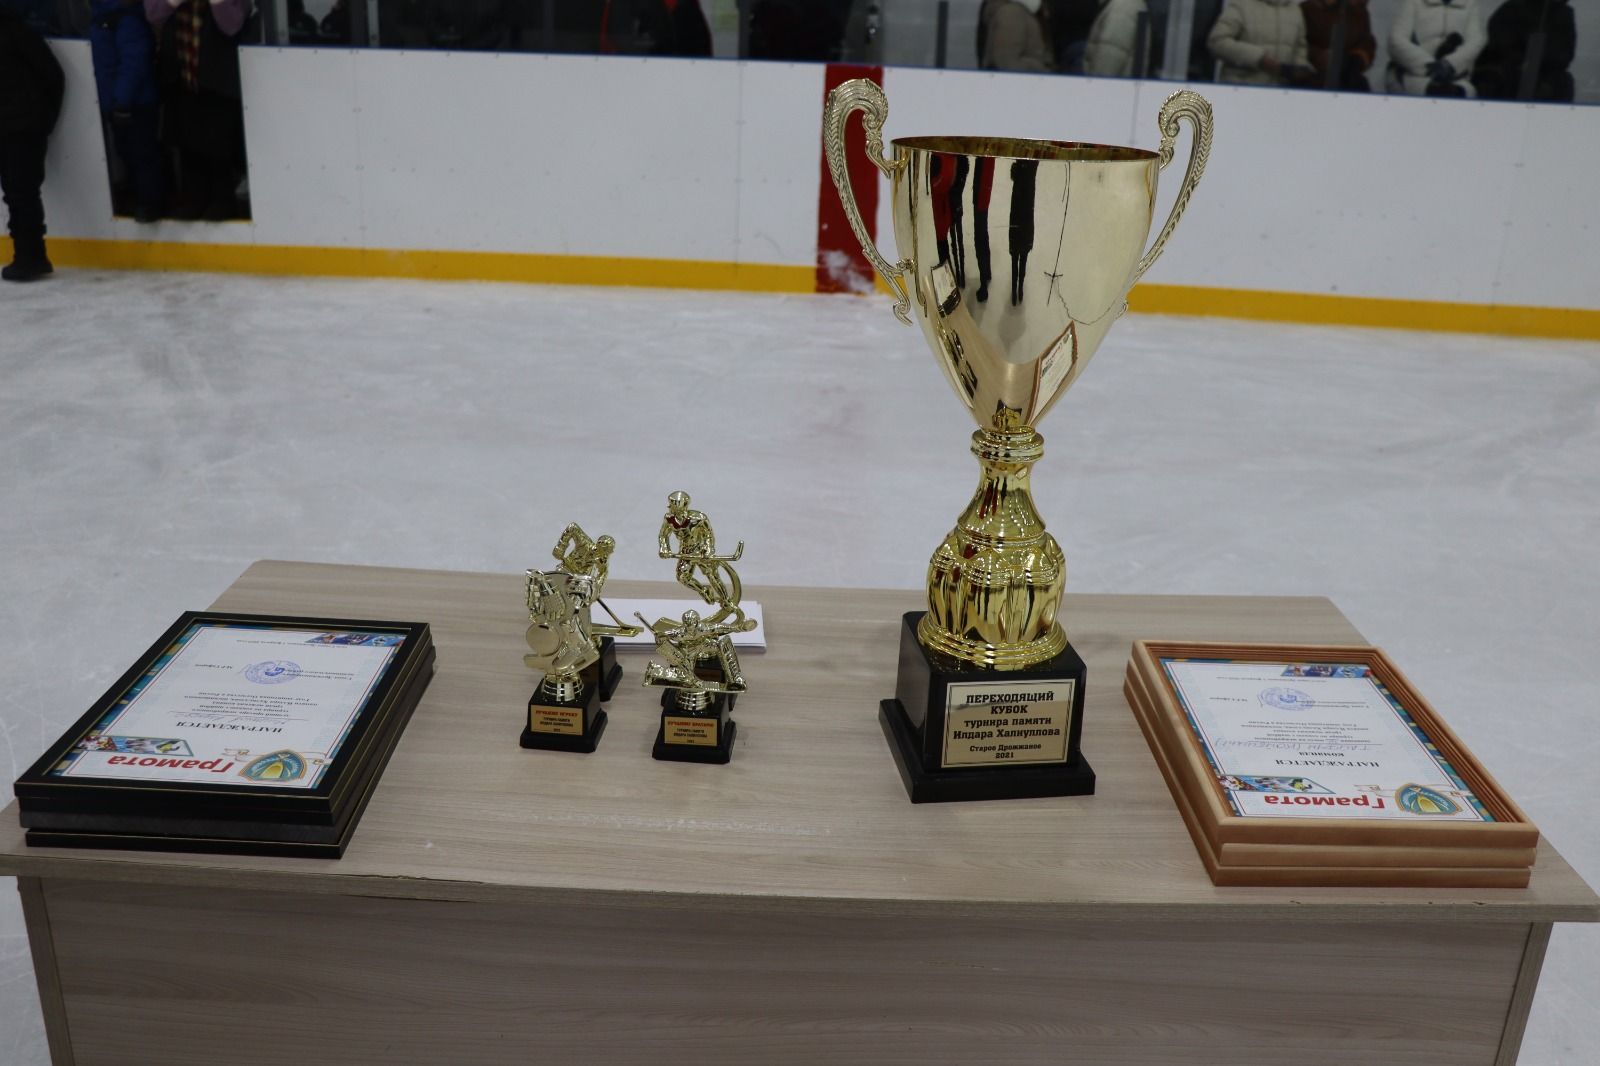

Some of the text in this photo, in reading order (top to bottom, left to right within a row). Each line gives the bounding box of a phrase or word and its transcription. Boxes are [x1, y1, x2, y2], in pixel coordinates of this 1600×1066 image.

[966, 691, 1054, 704] ПЕРЕХОДЯЩИЙ
[991, 705, 1028, 715] КУБОК
[176, 721, 282, 733] НАГРАЖДАЕТСЯ
[964, 717, 1052, 729] турнира памяти
[953, 730, 993, 740] Илдара
[108, 756, 234, 773] Грамота
[1275, 759, 1380, 768] НАГРАЖДАЕТСЯ
[1264, 795, 1386, 809] Грамота
